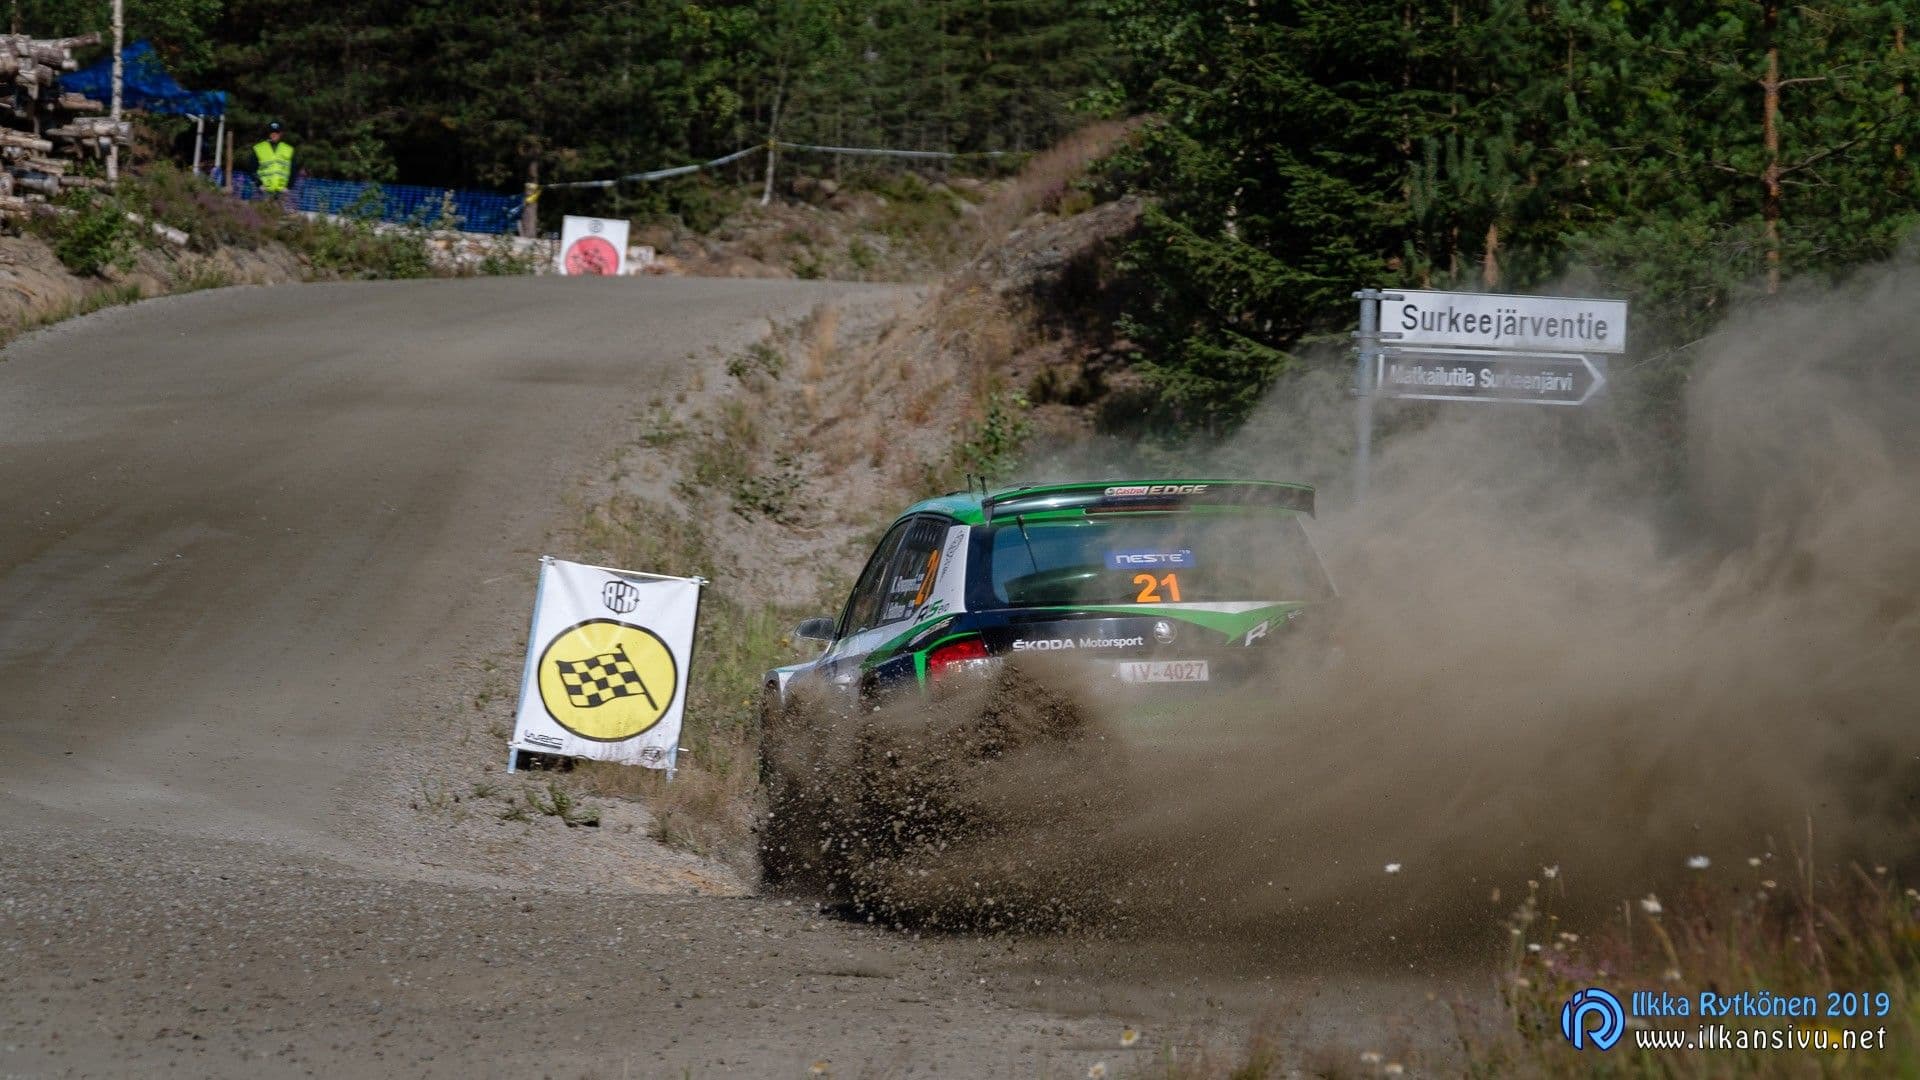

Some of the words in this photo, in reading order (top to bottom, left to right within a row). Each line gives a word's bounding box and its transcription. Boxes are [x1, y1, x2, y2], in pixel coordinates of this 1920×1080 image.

[1401, 303, 1609, 340] Surkeejärventie
[1390, 364, 1476, 388] Matkailutila
[1480, 367, 1573, 394] Surkeenjärvi
[1149, 484, 1209, 496] EDGE
[1115, 553, 1184, 564] NESTE
[1132, 573, 1182, 603] 21
[1012, 638, 1075, 651] ŠKODA
[1079, 635, 1144, 649] Motorsport
